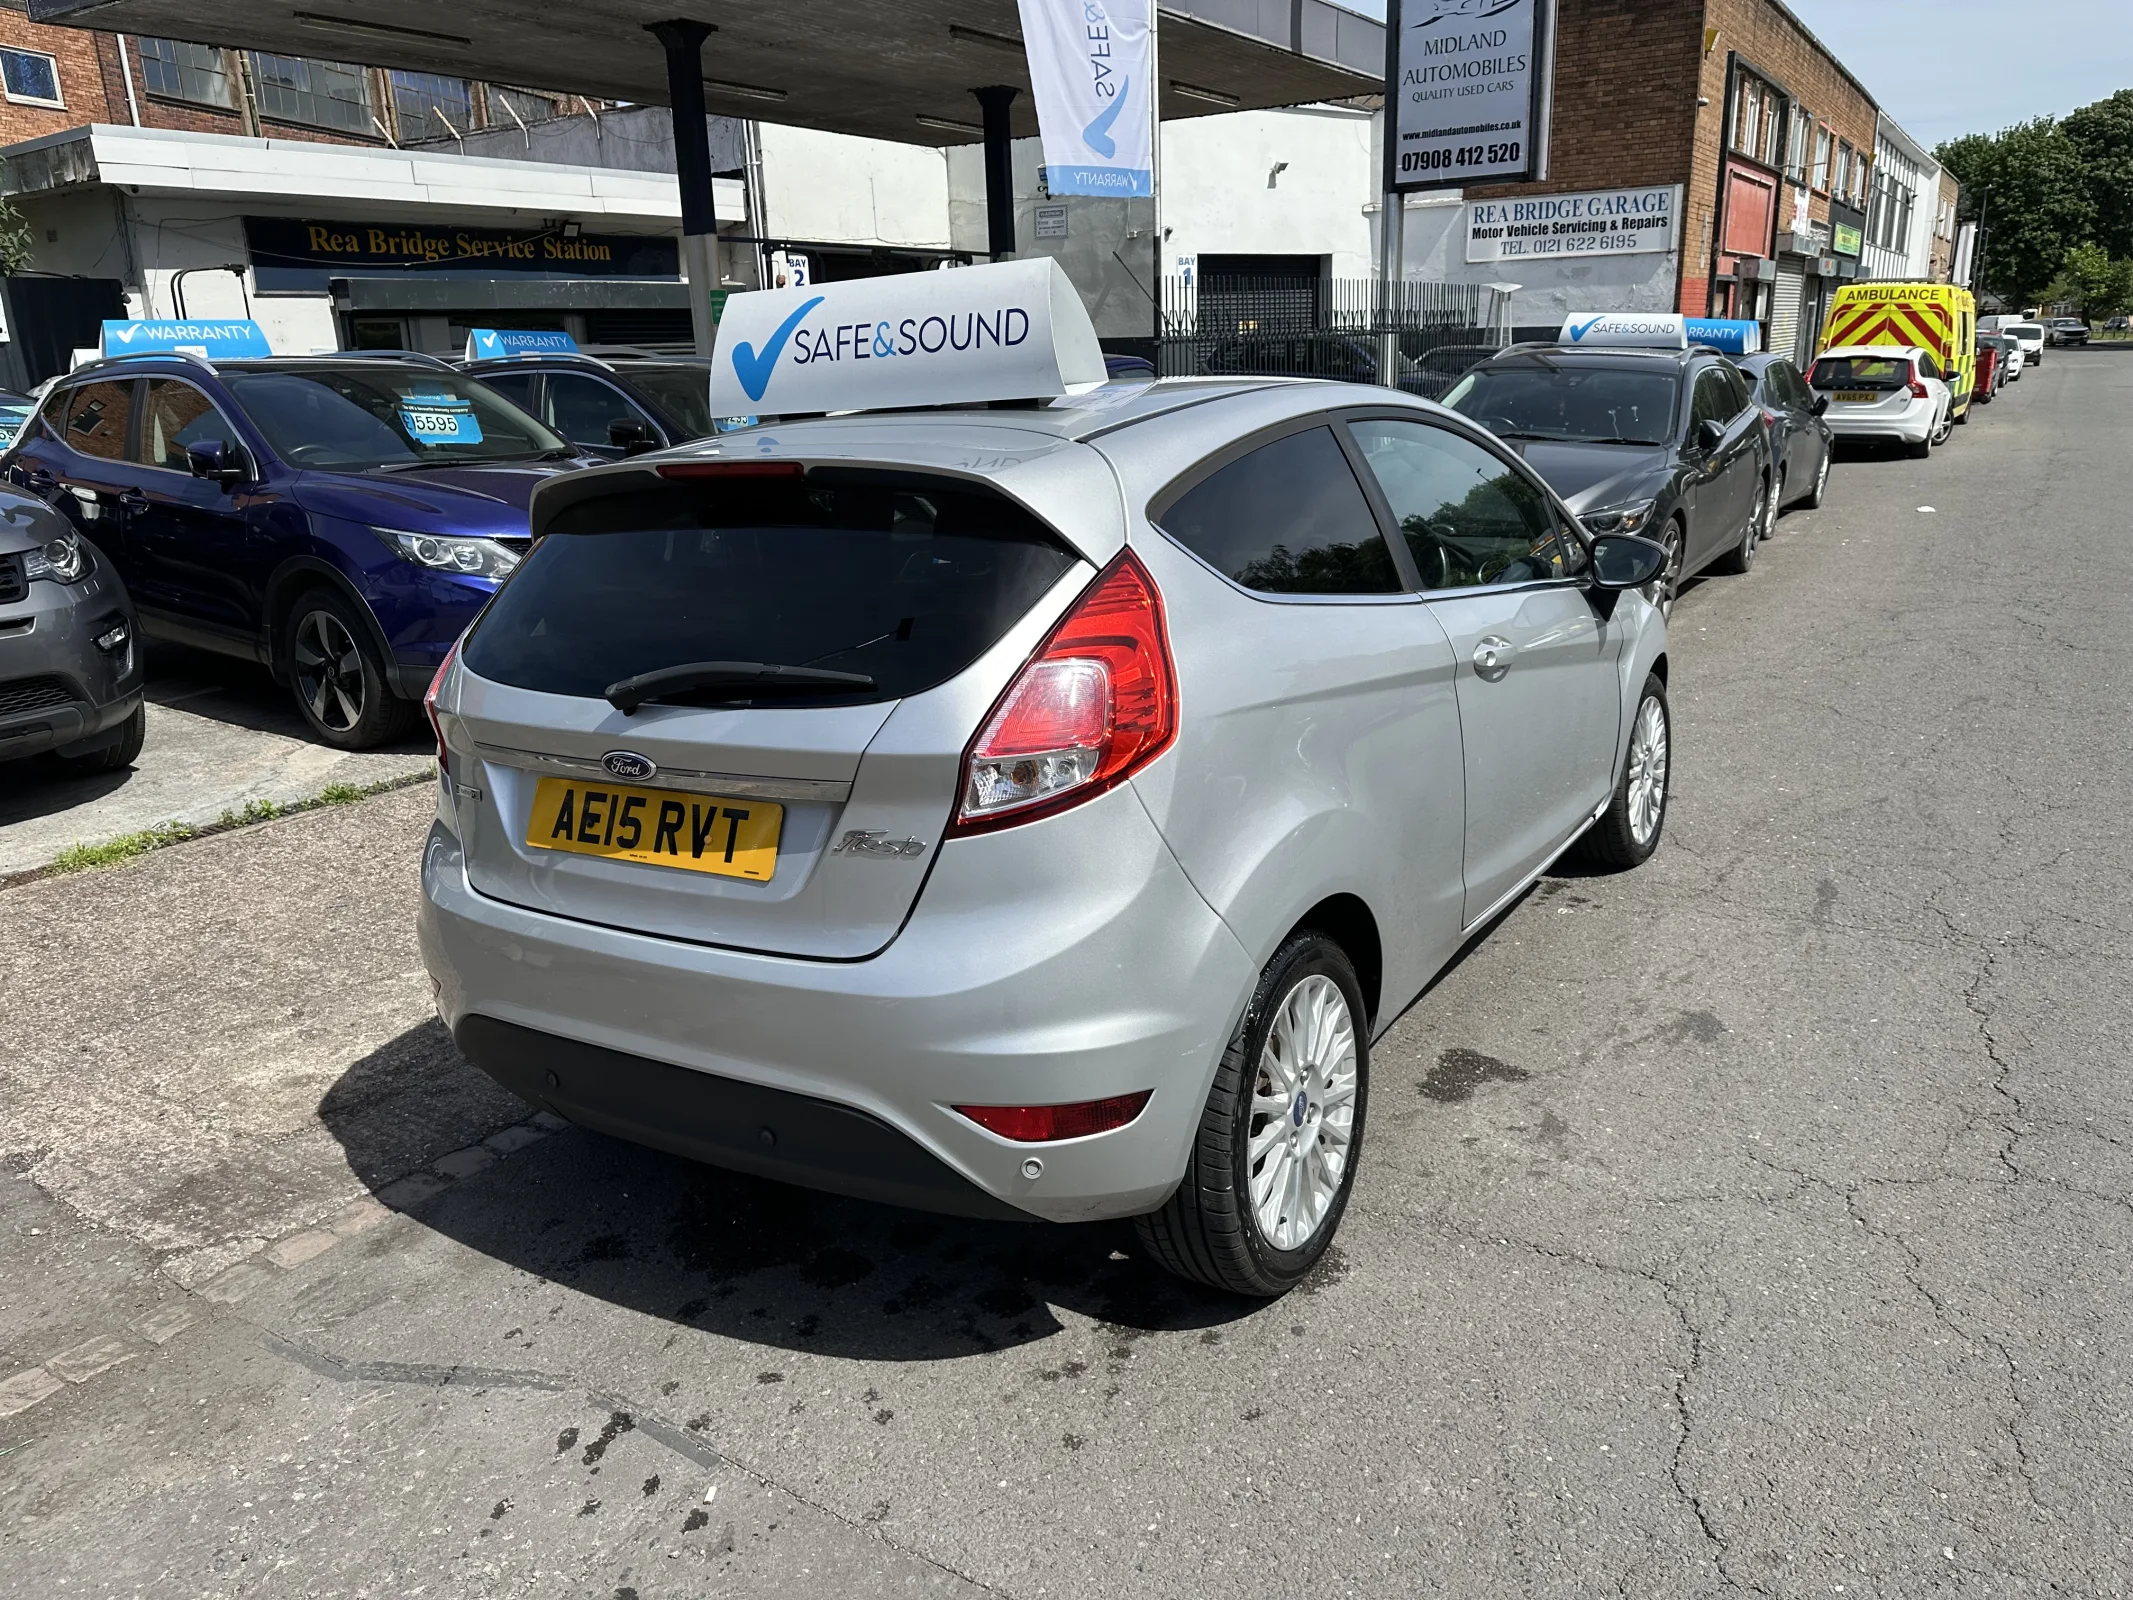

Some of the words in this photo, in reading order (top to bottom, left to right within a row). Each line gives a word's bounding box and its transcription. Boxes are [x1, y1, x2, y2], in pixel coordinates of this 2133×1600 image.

[1424, 29, 1507, 56] MIDLAND
[1403, 54, 1526, 86] AUTOMOBILES
[1412, 87, 1455, 103] QUALITY
[1457, 84, 1484, 96] USED
[1487, 80, 1514, 92] CARS
[1402, 120, 1521, 140] www.midlandautomobiles.co.uk
[1401, 149, 1452, 172] 07908
[1456, 146, 1484, 166] 412
[1487, 142, 1520, 164] 520
[1473, 205, 1508, 224] REA
[1514, 198, 1583, 221] BRIDGE
[1588, 192, 1669, 216] GARAGE
[1472, 226, 1504, 240] Motor
[1507, 222, 1549, 237] Vehicle
[1552, 219, 1606, 235] Servicing
[1610, 219, 1618, 231] &
[1621, 215, 1668, 231] Repairs
[307, 226, 360, 253] Rea
[367, 229, 450, 263] Bridge
[456, 233, 535, 259] Service
[543, 236, 612, 261] Station
[1501, 240, 1530, 255] TEL.
[1533, 239, 1561, 254] 0121
[1566, 236, 1596, 251] 622
[1600, 234, 1637, 249] 6195
[789, 258, 807, 268] BAY
[1178, 257, 1196, 266] BAY
[794, 269, 805, 287] 2
[1182, 267, 1192, 286] 1
[1845, 288, 1941, 301] AMBULANCE
[143, 325, 251, 340] WARRANTY
[793, 307, 1029, 365] SAFE&SOUND
[1592, 323, 1675, 334] SAFE&SOUND
[1687, 326, 1739, 339] RRANTY
[499, 335, 567, 348] WARRANTY
[414, 415, 457, 432] 5595
[610, 755, 641, 777] Ford
[551, 788, 647, 850] AE15
[652, 800, 750, 864] RVT
